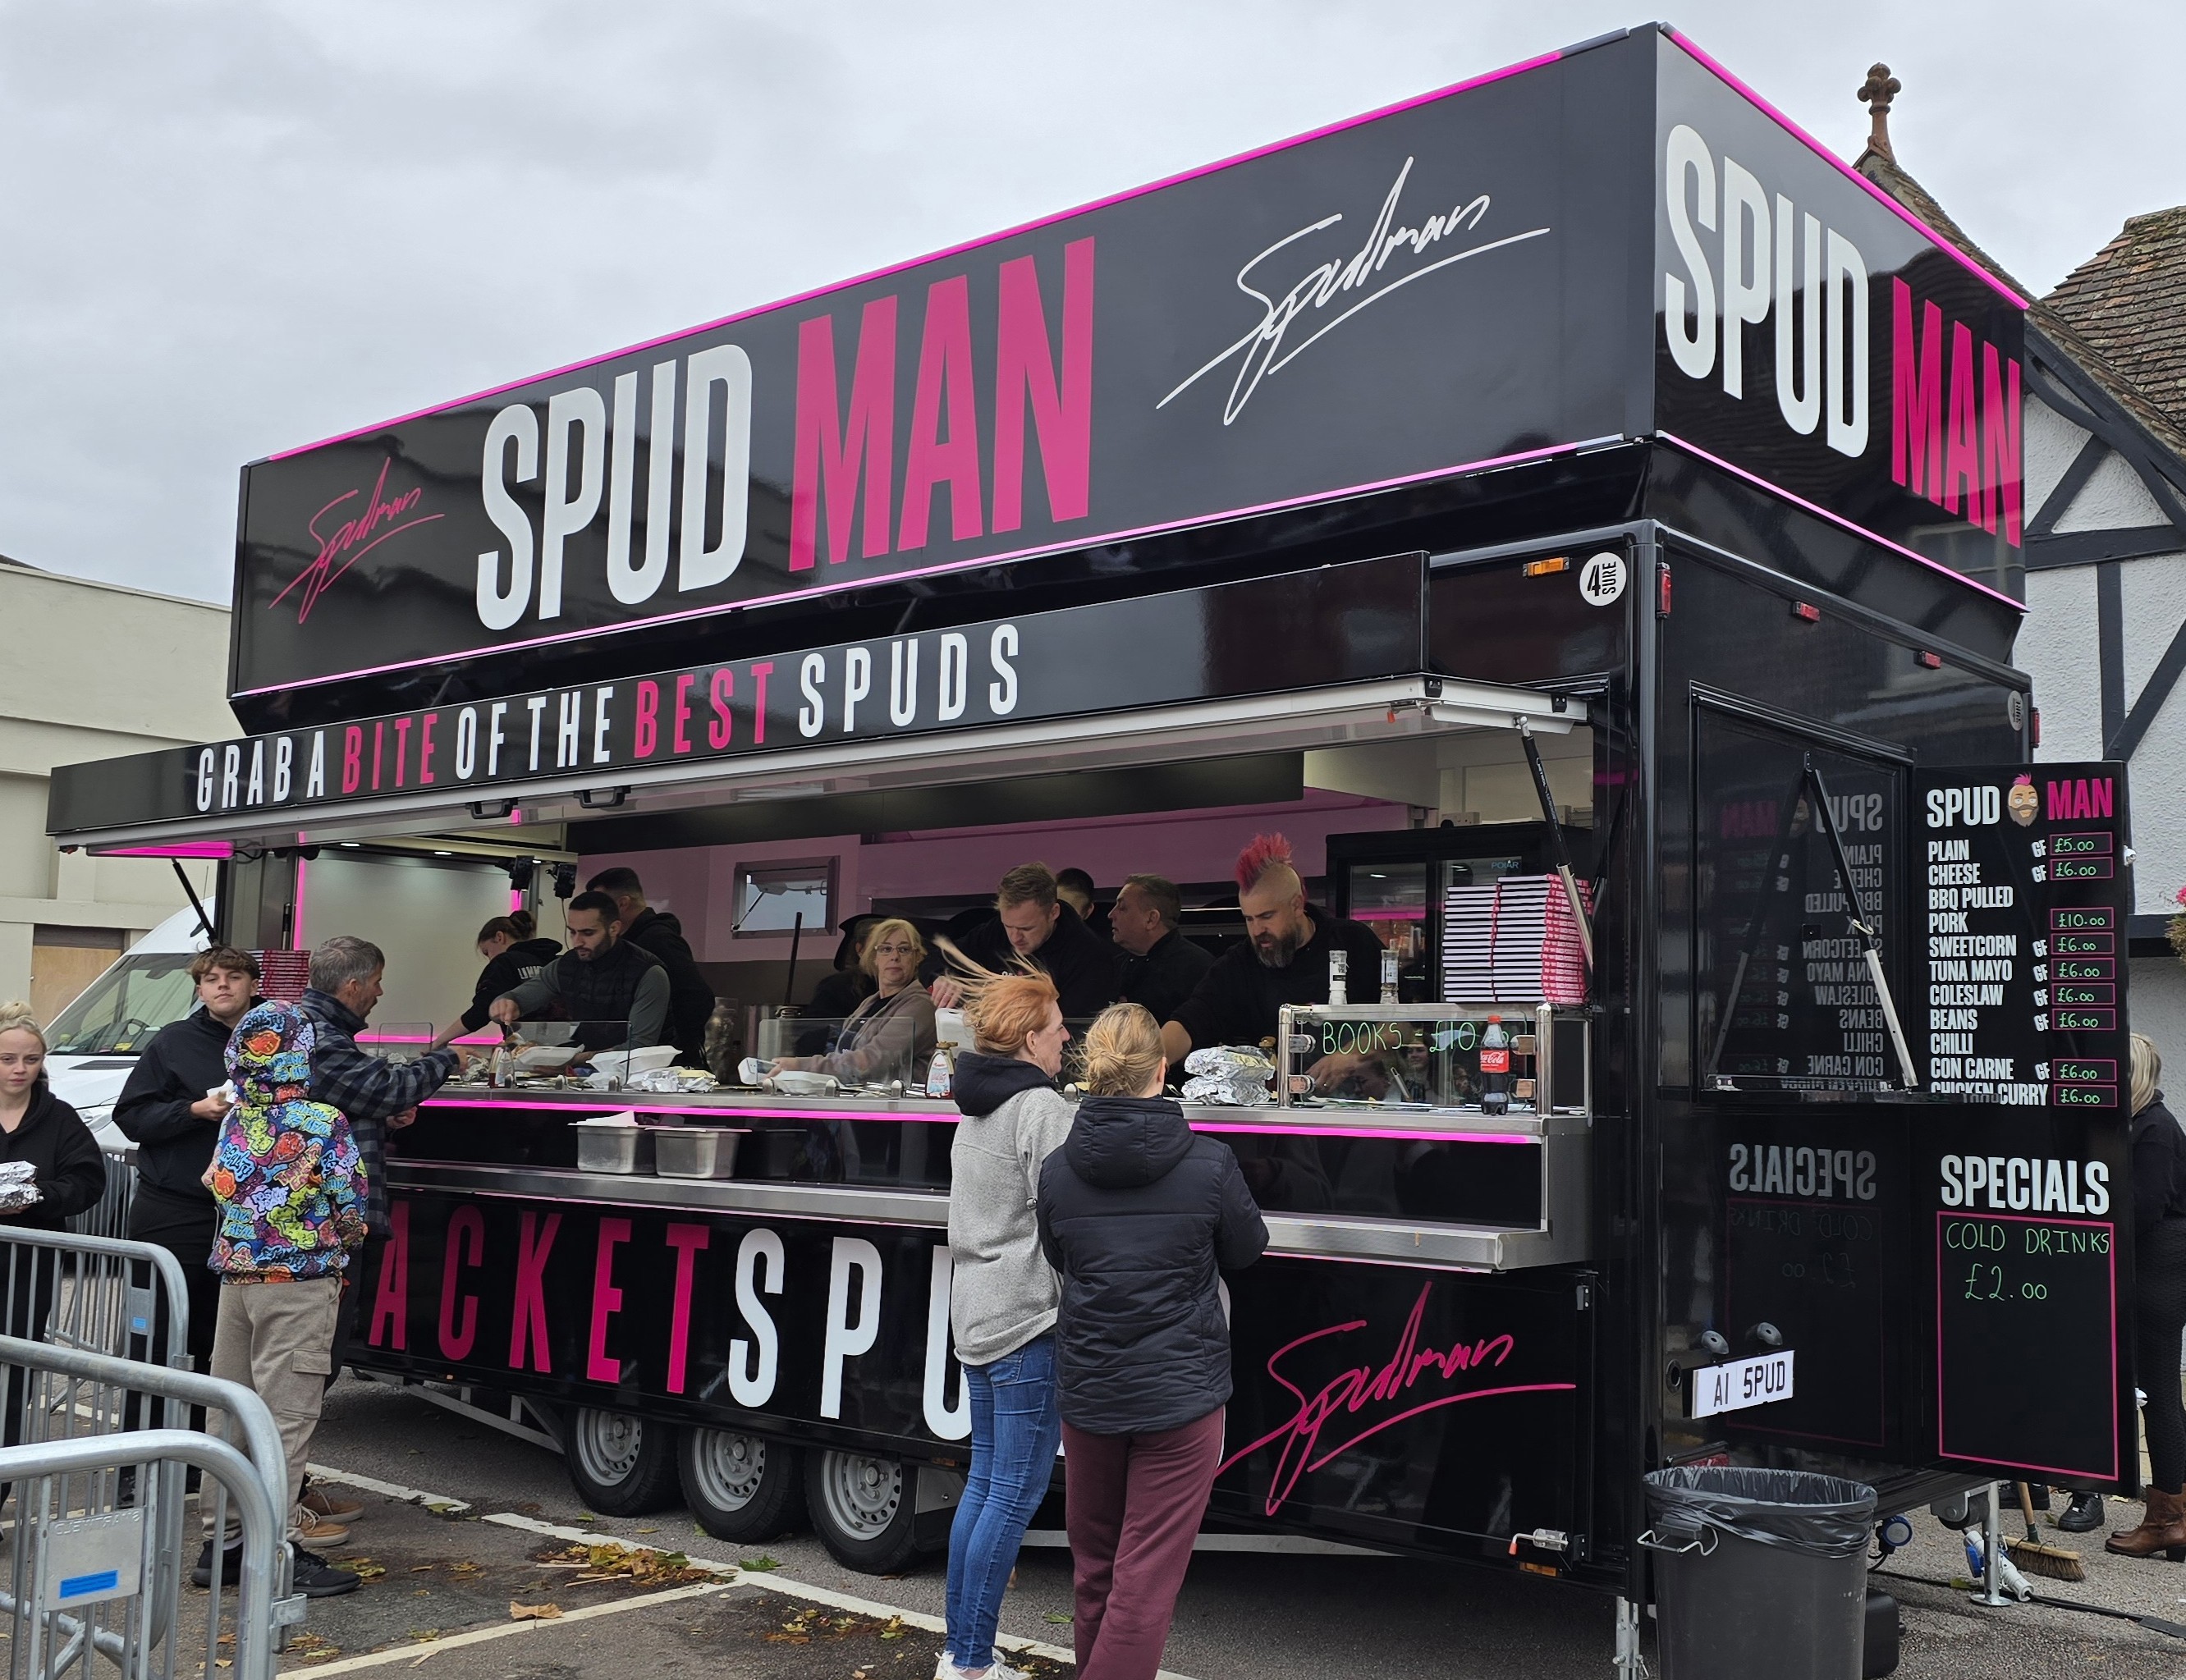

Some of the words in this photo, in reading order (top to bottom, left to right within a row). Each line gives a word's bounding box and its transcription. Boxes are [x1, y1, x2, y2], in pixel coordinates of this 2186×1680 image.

[1156, 156, 1550, 425] Spudman
[1666, 124, 1868, 457] SPUD
[1892, 276, 2020, 548] MAN
[476, 344, 752, 630] SPUD
[788, 236, 1094, 572] MAN
[1587, 565, 1601, 597] 4
[1602, 561, 1616, 595] SURE
[196, 736, 292, 812] GRAB
[307, 731, 324, 798] A
[342, 714, 438, 793] BITE
[456, 707, 506, 780] OF
[527, 687, 614, 771] THE
[635, 662, 773, 758] BEST
[799, 624, 1019, 737] SPUDS
[1927, 786, 2000, 827] SPUD
[2048, 779, 2112, 819] MAN
[1491, 860, 1519, 869] POLAR
[1928, 840, 1969, 862] PLAIN
[2031, 840, 2046, 858] GF
[2055, 839, 2094, 854] £5.00
[1928, 863, 1980, 885] CHEESE
[2031, 864, 2046, 882] GF
[2055, 863, 2097, 877] £6.00
[1929, 888, 1959, 910] BBQ
[1962, 886, 2014, 908] PULLED
[1929, 912, 1968, 934] PORK
[2058, 914, 2105, 927] £10.00
[1929, 935, 2017, 958] SWEETCORN
[2032, 939, 2048, 957] GF
[2057, 940, 2096, 952] £6.00
[1929, 961, 1968, 982] TUNA
[1971, 960, 2013, 982] MAYO
[2032, 964, 2048, 982] GF
[2059, 964, 2100, 978] £6.00
[1930, 985, 2004, 1006] COLESLAW
[2032, 988, 2048, 1006] GF
[2057, 991, 2095, 1003] £6.00
[1930, 1009, 1977, 1030] BEANS
[2033, 1013, 2049, 1031] GF
[2059, 1015, 2098, 1028] £6.00
[1322, 1021, 1402, 1055] BOOKS
[1930, 1033, 1973, 1055] CHILLI
[1931, 1058, 1962, 1079] CON
[1965, 1058, 2014, 1080] CARNE
[2035, 1062, 2051, 1080] GF
[2060, 1067, 2098, 1080] £6.00
[1997, 1083, 2049, 1106] CURRY
[2060, 1090, 2100, 1105] £6.00
[1941, 1155, 2110, 1215] SPECIALS
[1946, 1223, 2005, 1252] COLD
[2025, 1229, 2110, 1257] DRINKS
[1964, 1264, 2047, 1301] £2.00
[369, 1201, 708, 1394] ACKET
